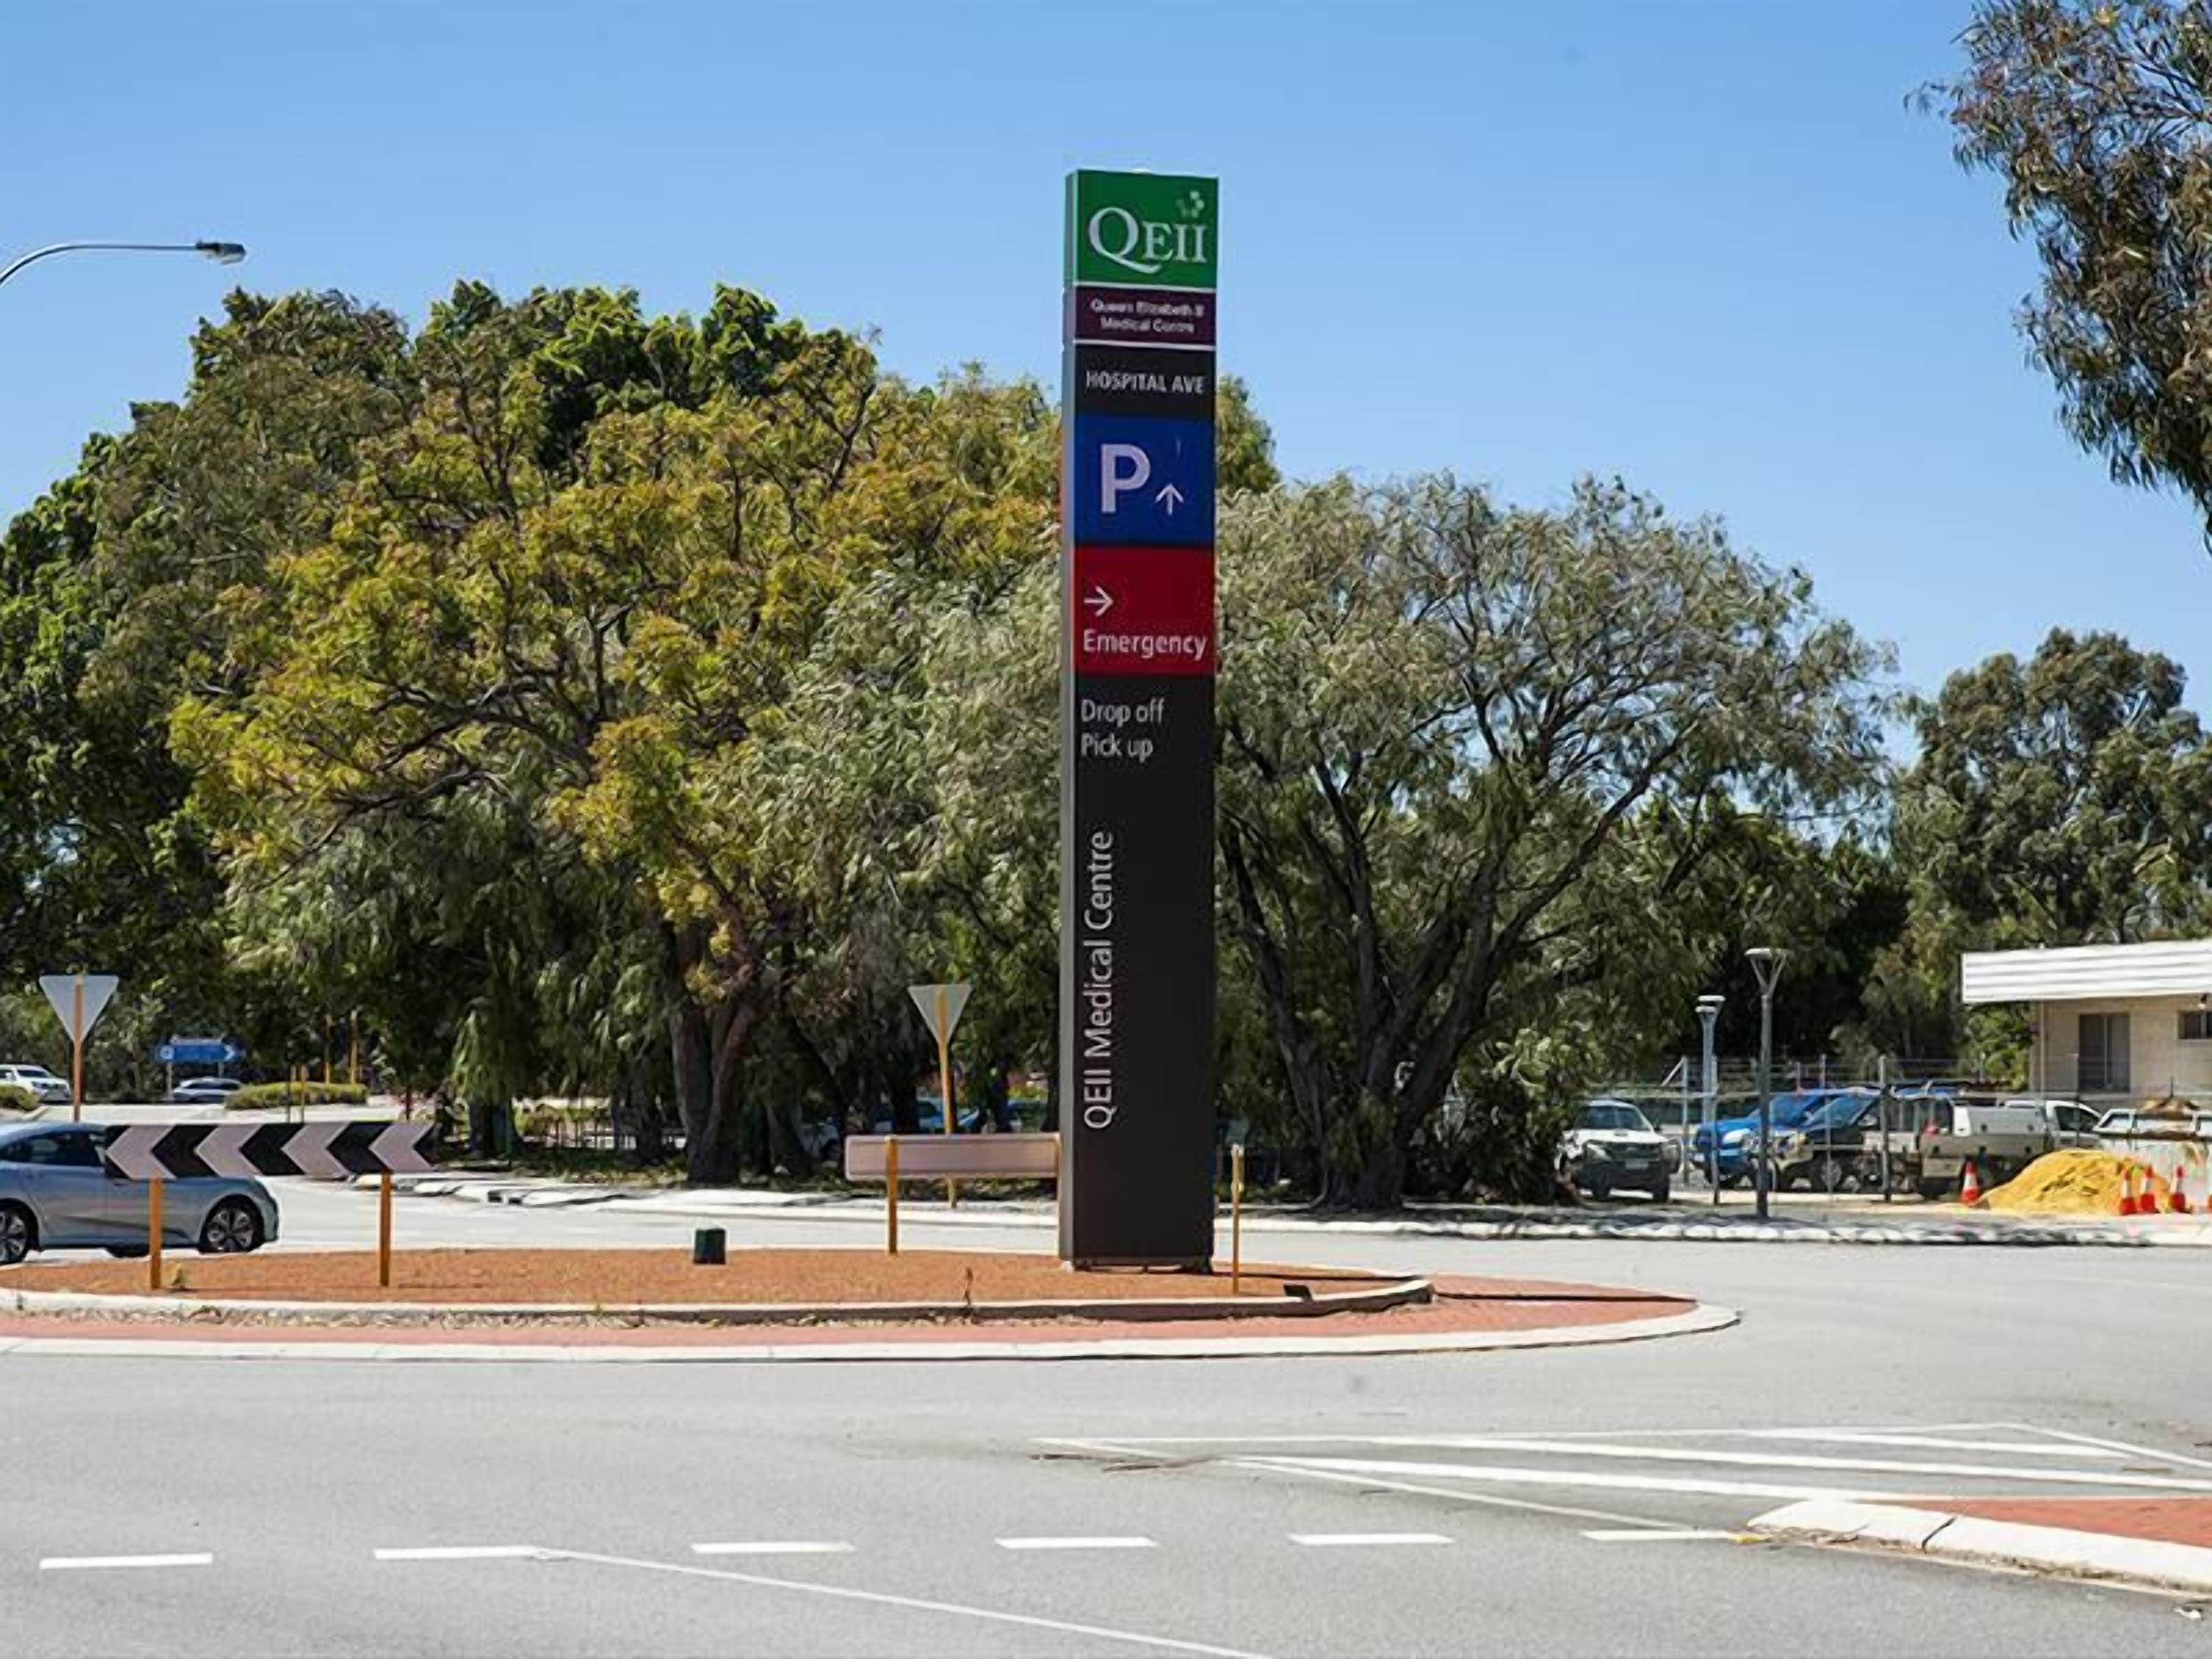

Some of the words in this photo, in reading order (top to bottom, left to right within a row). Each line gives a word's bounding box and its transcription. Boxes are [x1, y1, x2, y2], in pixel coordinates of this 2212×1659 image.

[1089, 207, 1207, 274] QEII
[1086, 369, 1167, 393] HOSPITAL
[1172, 375, 1204, 395] AVE
[1100, 443, 1151, 514] P
[1083, 628, 1208, 661] Emergency
[1081, 699, 1131, 728] Drop
[1136, 697, 1165, 723] off
[1080, 732, 1123, 757] Pick
[1127, 738, 1154, 762] up
[1084, 831, 1114, 930] Centre
[1082, 941, 1112, 1057] Medical
[1084, 1070, 1118, 1130] QEII
